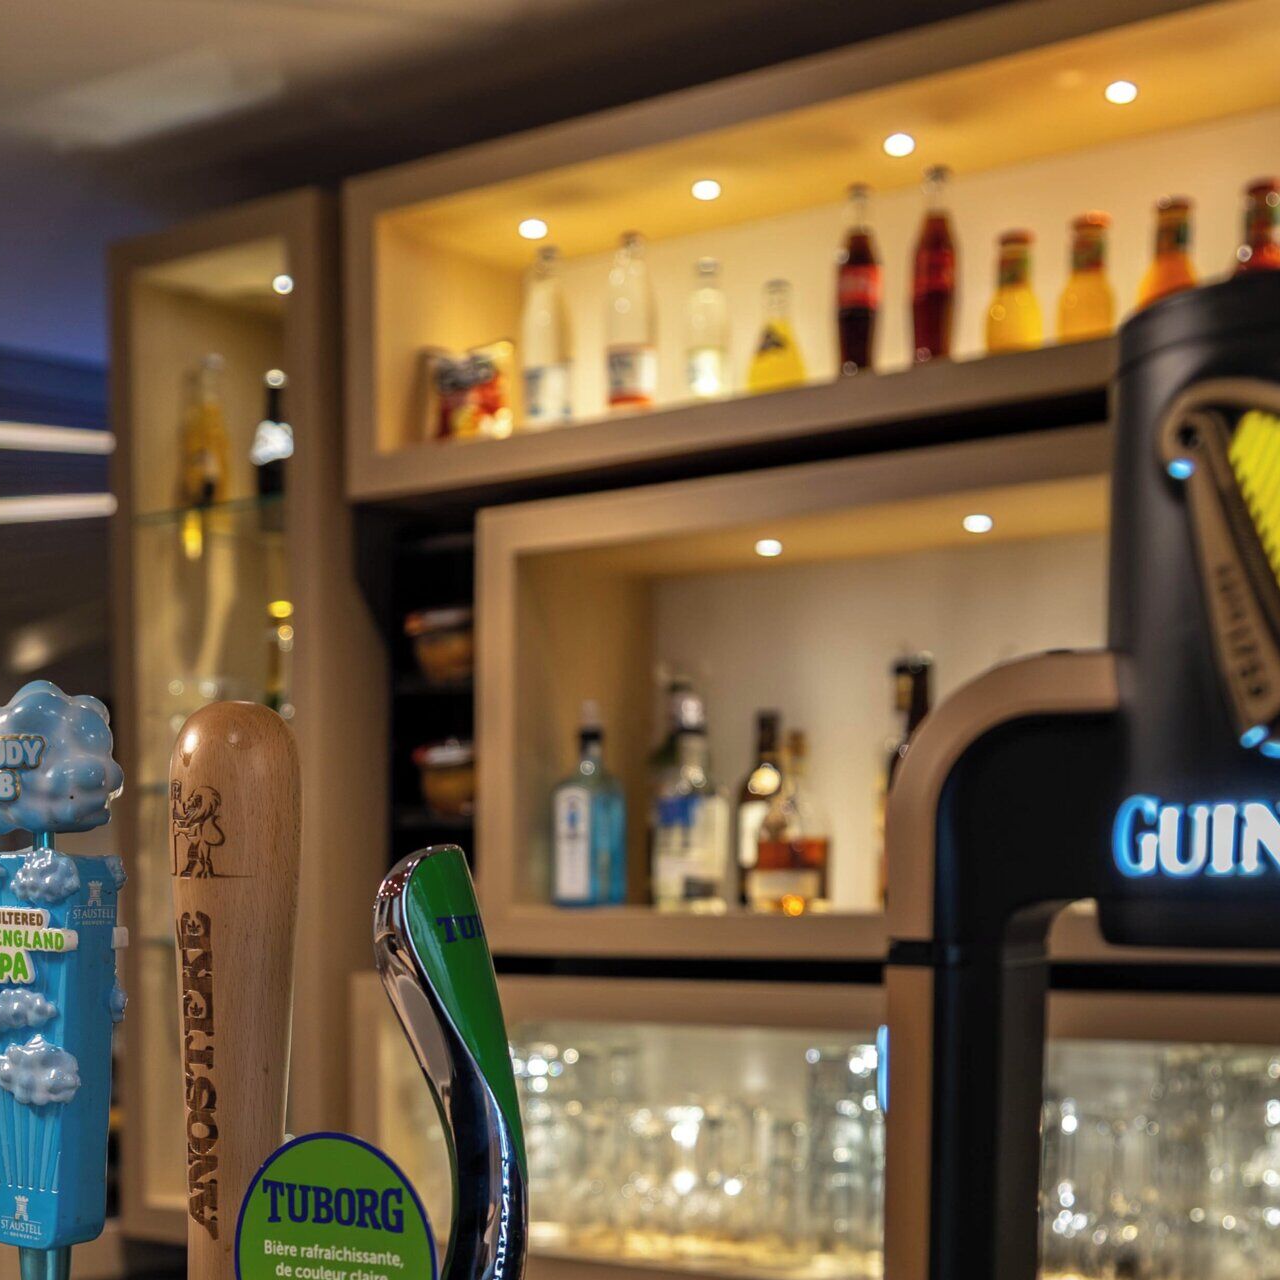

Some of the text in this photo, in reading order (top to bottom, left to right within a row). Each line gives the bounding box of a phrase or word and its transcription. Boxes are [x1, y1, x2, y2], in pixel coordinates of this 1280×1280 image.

[82, 908, 115, 920] AUSTELL
[262, 1178, 405, 1234] TUBORG
[8, 1220, 42, 1236] AUSTELL
[264, 1239, 404, 1270] Bière rafraîchissante,
[275, 1262, 292, 1277] de
